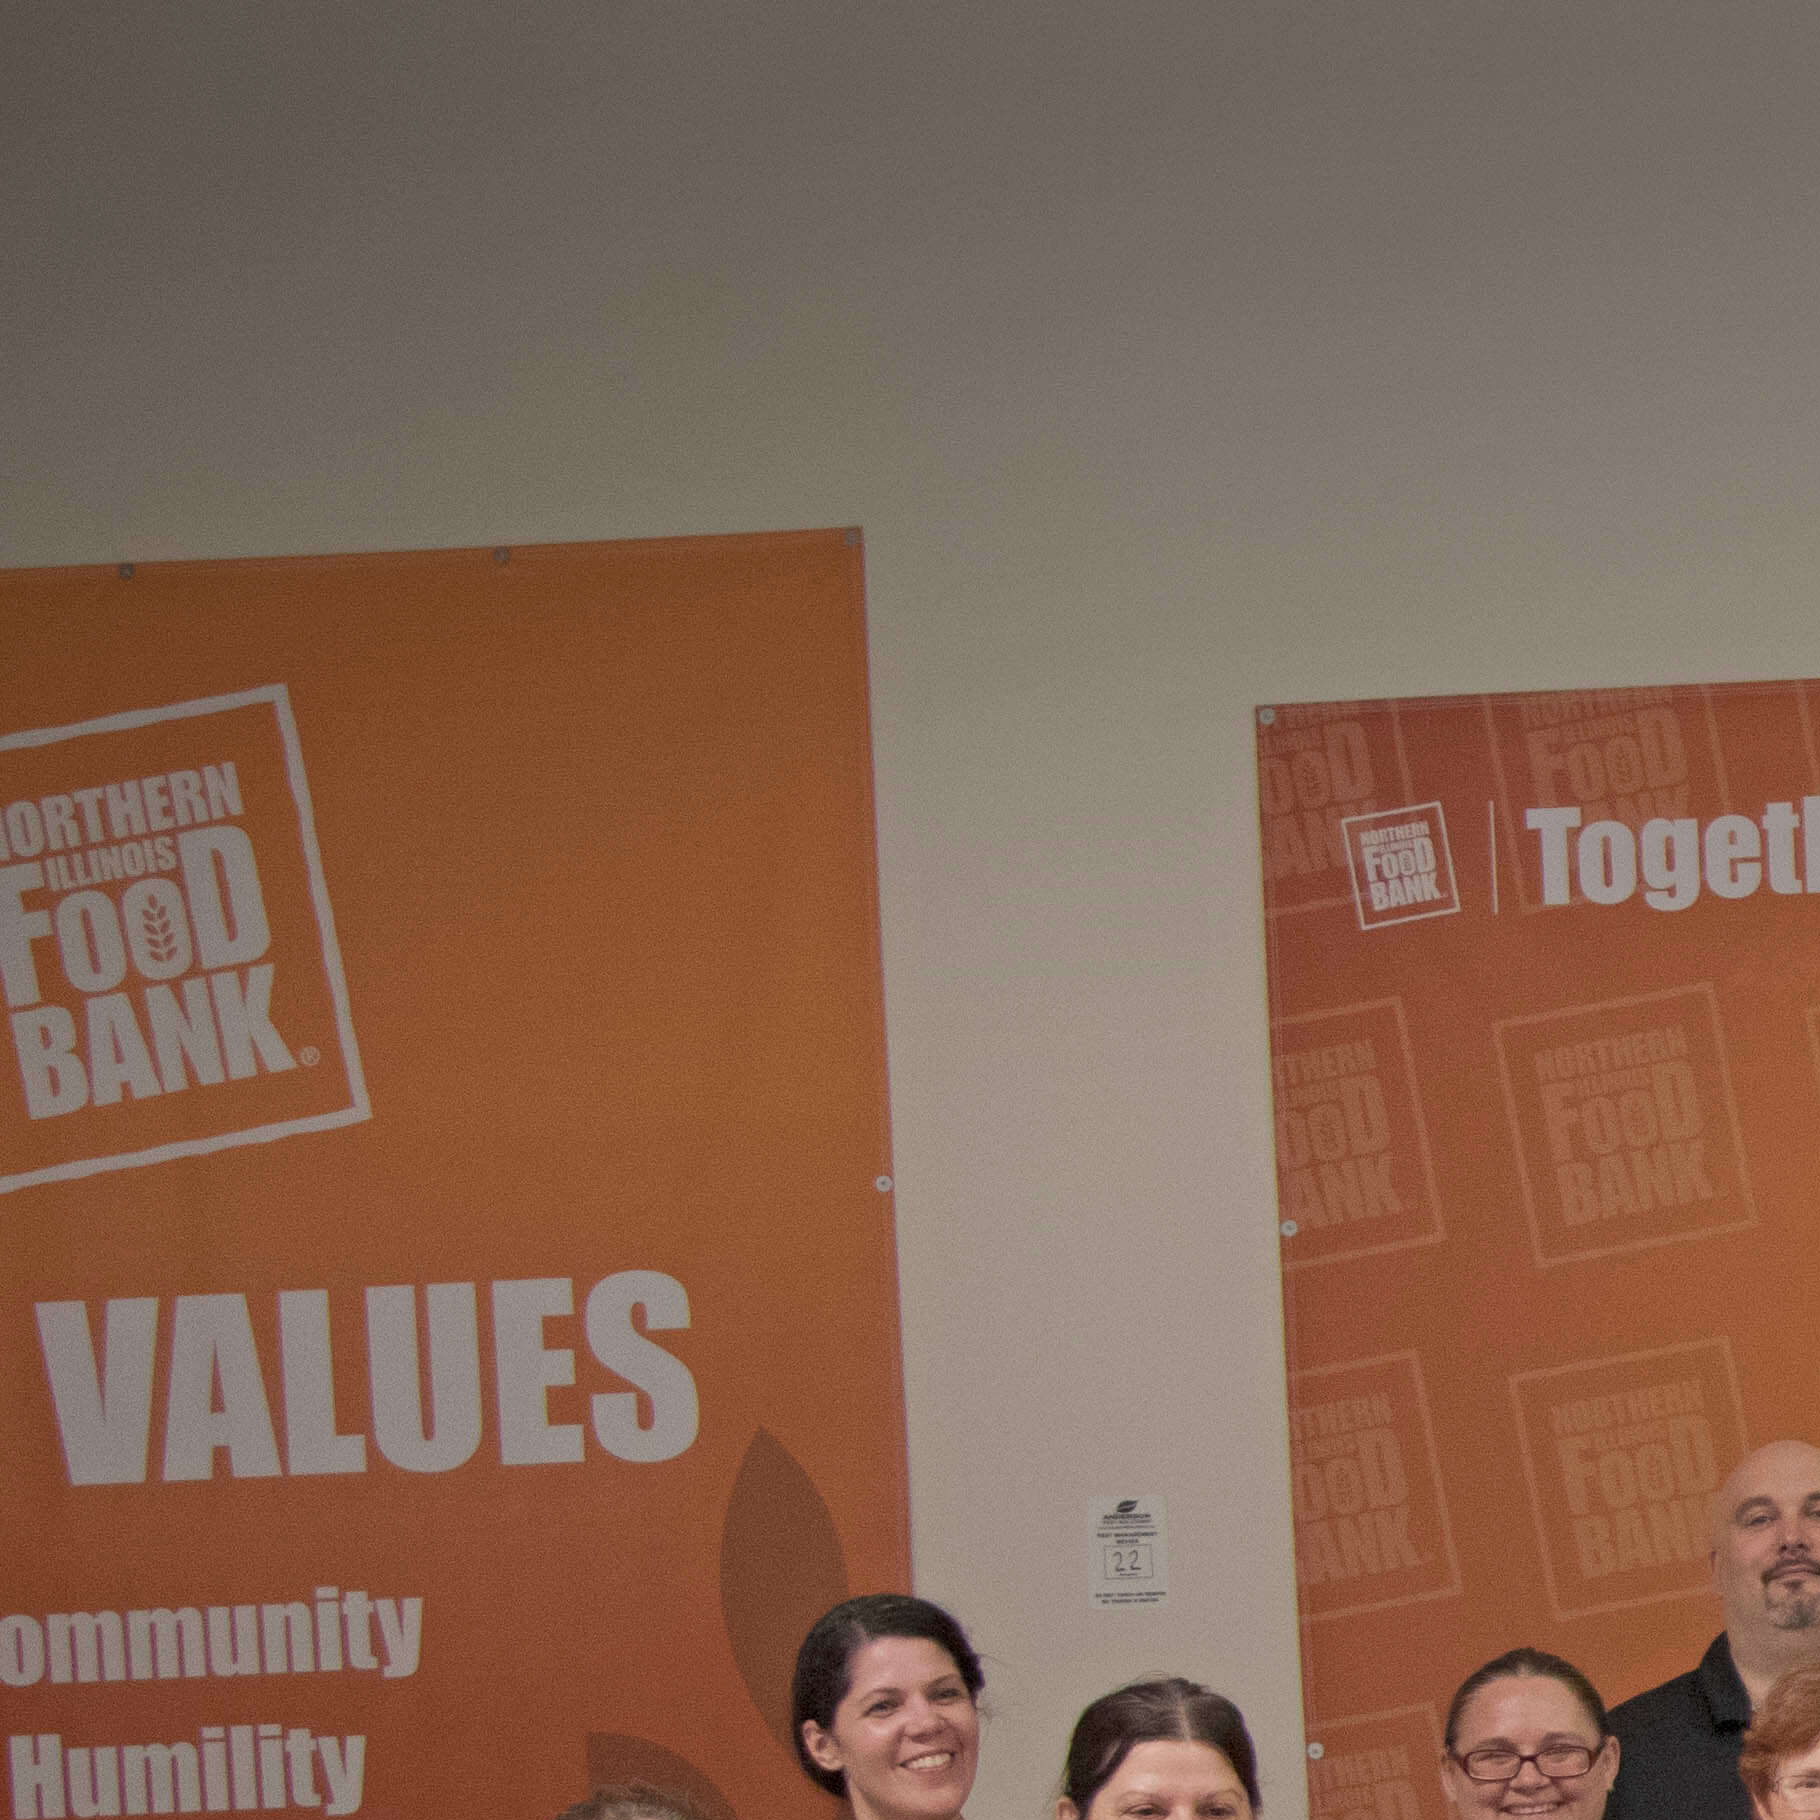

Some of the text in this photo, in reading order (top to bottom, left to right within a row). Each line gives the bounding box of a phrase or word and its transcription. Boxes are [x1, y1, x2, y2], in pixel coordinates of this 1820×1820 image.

[46, 836, 179, 892] ILLINOIS
[1363, 836, 1436, 882] FOOD
[1370, 871, 1440, 912] BANK
[0, 825, 271, 1008] FOOD
[10, 964, 297, 1121] BANK
[34, 1269, 699, 1487] VALUES
[1113, 1549, 1142, 1572] 22
[0, 1586, 423, 1687] ommunity
[9, 1723, 367, 1820] Humility
